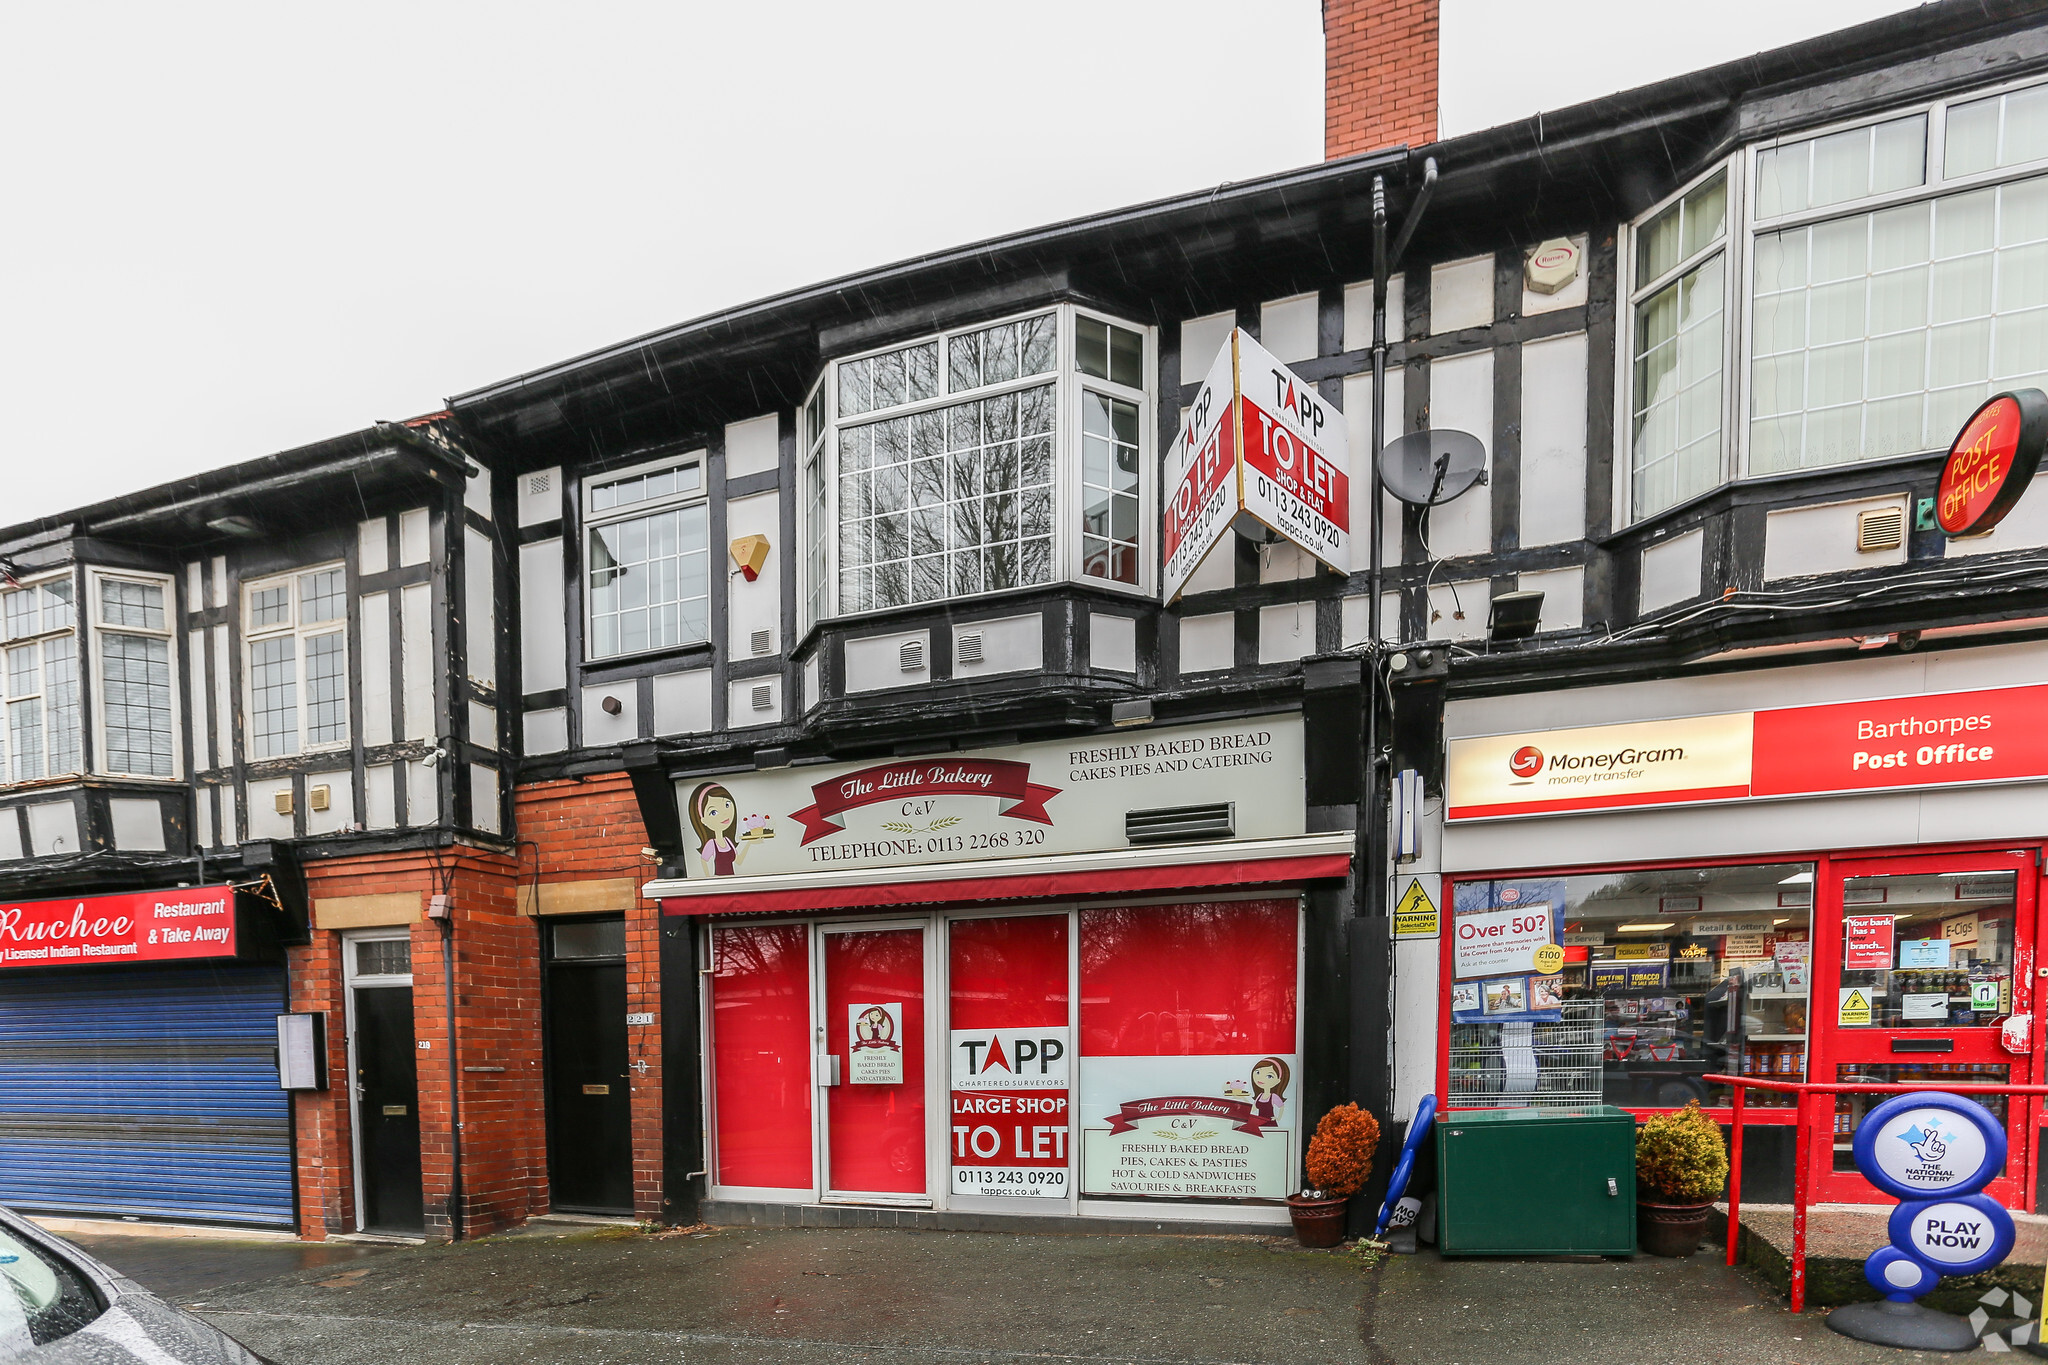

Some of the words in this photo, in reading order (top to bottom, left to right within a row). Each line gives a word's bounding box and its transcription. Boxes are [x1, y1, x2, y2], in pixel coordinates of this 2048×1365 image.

[1272, 369, 1324, 437] TAPP
[1179, 386, 1211, 468] TAPP
[1259, 411, 1295, 471] TO
[1303, 446, 1336, 504] LET
[1951, 425, 1998, 486] POST
[1172, 479, 1191, 533] TO
[1197, 422, 1222, 496] LET
[1276, 467, 1298, 493] SHOP
[1300, 487, 1306, 501] &
[1307, 490, 1325, 514] FLAT
[1944, 454, 2000, 520] OFFICE
[1258, 476, 1287, 512] 0113
[1291, 499, 1311, 529] 243
[1314, 516, 1340, 549] 0920
[1170, 541, 1188, 578] 0113
[1188, 520, 1203, 553] 243
[1205, 484, 1226, 528] 0920
[1180, 511, 1195, 539] SHOP
[1277, 513, 1325, 555] tappcs.co.uk
[1857, 714, 1992, 740] Barthorpes
[1069, 745, 1140, 765] FRESHLY
[1144, 738, 1205, 758] BAKED
[1209, 731, 1271, 751] BREAD
[1852, 750, 1908, 771] Post
[1916, 743, 1994, 766] Office
[1069, 766, 1117, 782] CAKES
[1120, 763, 1151, 778] PIES
[1154, 759, 1188, 774] AND
[1192, 751, 1272, 770] CATERING
[1549, 747, 1684, 771] MoneyGram
[841, 781, 874, 799] The
[878, 768, 924, 791] Little
[926, 766, 993, 788] Bakery
[1548, 773, 1591, 786] money
[1593, 768, 1645, 781] transfer
[901, 801, 913, 816] C
[914, 806, 923, 816] &
[923, 800, 936, 815] V
[807, 837, 923, 862] TELEPHONE:
[927, 835, 963, 853] 0113
[969, 831, 1009, 850] 2268
[1014, 829, 1045, 847] 320
[1962, 884, 2012, 895] Household
[154, 898, 226, 919] Restaurant
[0, 902, 135, 942] Ruchee
[1396, 914, 1436, 922] WARNING
[1458, 923, 1506, 940] Over
[1512, 914, 1546, 934] 50?
[1849, 918, 1868, 927] Your
[1869, 917, 1892, 926] bank
[148, 929, 158, 944] &
[161, 927, 191, 944] Take
[193, 925, 230, 944] Away
[1699, 925, 1724, 933] Retail
[1736, 923, 1768, 933] Lottery
[1852, 927, 1868, 935] has
[1946, 920, 1973, 938] E-Cigs
[1505, 937, 1532, 946] memories
[1533, 935, 1546, 943] with
[5, 946, 48, 961] Licensed
[50, 944, 81, 958] Indian
[82, 941, 138, 957] Restaurant
[1538, 950, 1561, 959] £100
[1680, 947, 1708, 957] VAPE
[1487, 957, 1509, 965] counter
[1631, 973, 1660, 981] TOBACCO
[628, 1015, 650, 1023] 221
[958, 1033, 1064, 1075] TAPP
[953, 1098, 1011, 1114] LARGE
[1016, 1097, 1067, 1113] SHOP
[1138, 1102, 1158, 1113] The
[1160, 1100, 1190, 1111] Little
[1191, 1100, 1230, 1114] Bakery
[1171, 1119, 1179, 1129] C
[1188, 1118, 1198, 1129] V
[953, 1125, 1001, 1159] TO
[1014, 1125, 1068, 1159] LET
[1121, 1143, 1167, 1154] FRESHLY
[1169, 1144, 1208, 1154] BAKED
[1210, 1145, 1249, 1155] BREAD
[1120, 1157, 1147, 1167] PIES,
[1149, 1157, 1186, 1167] CAKES
[1188, 1158, 1199, 1167] &
[1202, 1158, 1248, 1168] PASTIES
[958, 1170, 993, 1184] 0113
[997, 1170, 1024, 1184] 243
[1028, 1171, 1064, 1185] 0920
[1112, 1169, 1135, 1179] HOT
[1137, 1170, 1147, 1179] &
[1150, 1170, 1180, 1180] COLD
[1182, 1171, 1257, 1181] SANDWICHES
[1905, 1168, 1954, 1176] NATIONAL
[1907, 1174, 1951, 1182] LOTTERY
[980, 1186, 1041, 1197] tappcs.co.uk
[1110, 1182, 1170, 1192] SAVOURIES
[1172, 1183, 1182, 1193] &
[1185, 1184, 1257, 1194] BREAKFASTS
[1926, 1219, 1981, 1236] PLAY
[1925, 1233, 1981, 1249] NOW
